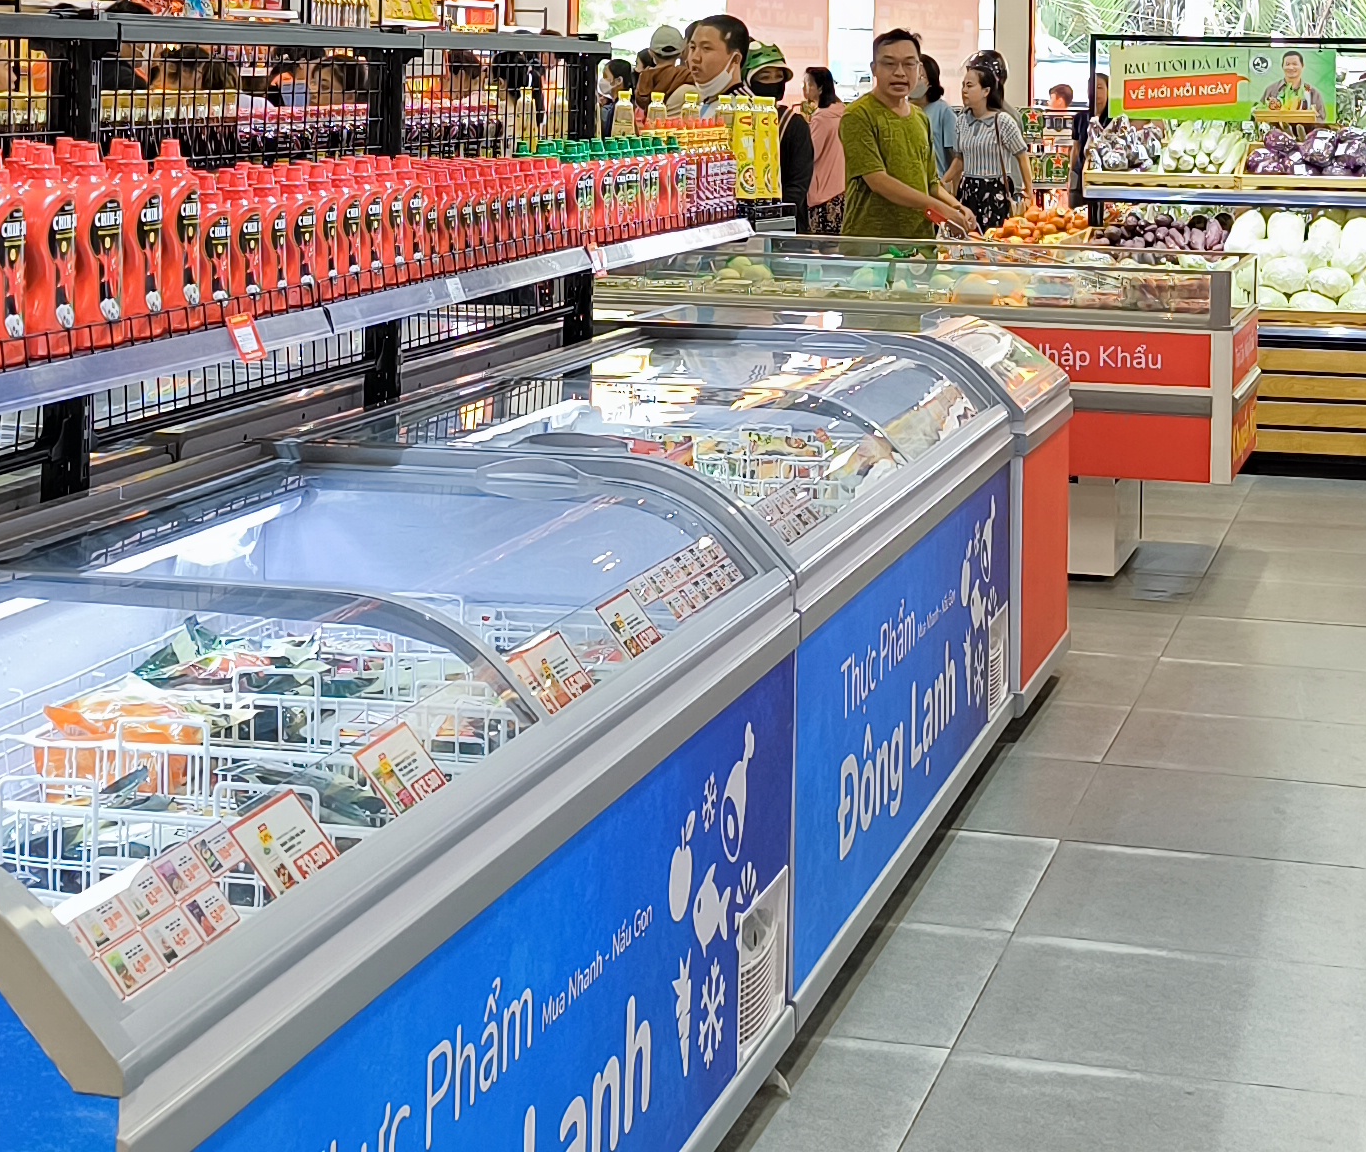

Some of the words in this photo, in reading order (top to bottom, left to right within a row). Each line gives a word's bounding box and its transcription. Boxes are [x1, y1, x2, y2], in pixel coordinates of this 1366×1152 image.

[1199, 82, 1232, 96] NGÀY
[1099, 345, 1162, 370] Khẩu
[841, 644, 877, 719] Thực
[880, 598, 915, 681] Phẩm
[837, 721, 904, 861] Đông
[910, 640, 956, 776] Lạnh
[425, 976, 533, 1151] Phẩm
[540, 988, 566, 1033] Mua
[568, 950, 604, 1004] Nhanh
[611, 918, 632, 961] Nấu
[633, 904, 653, 938] Gọn
